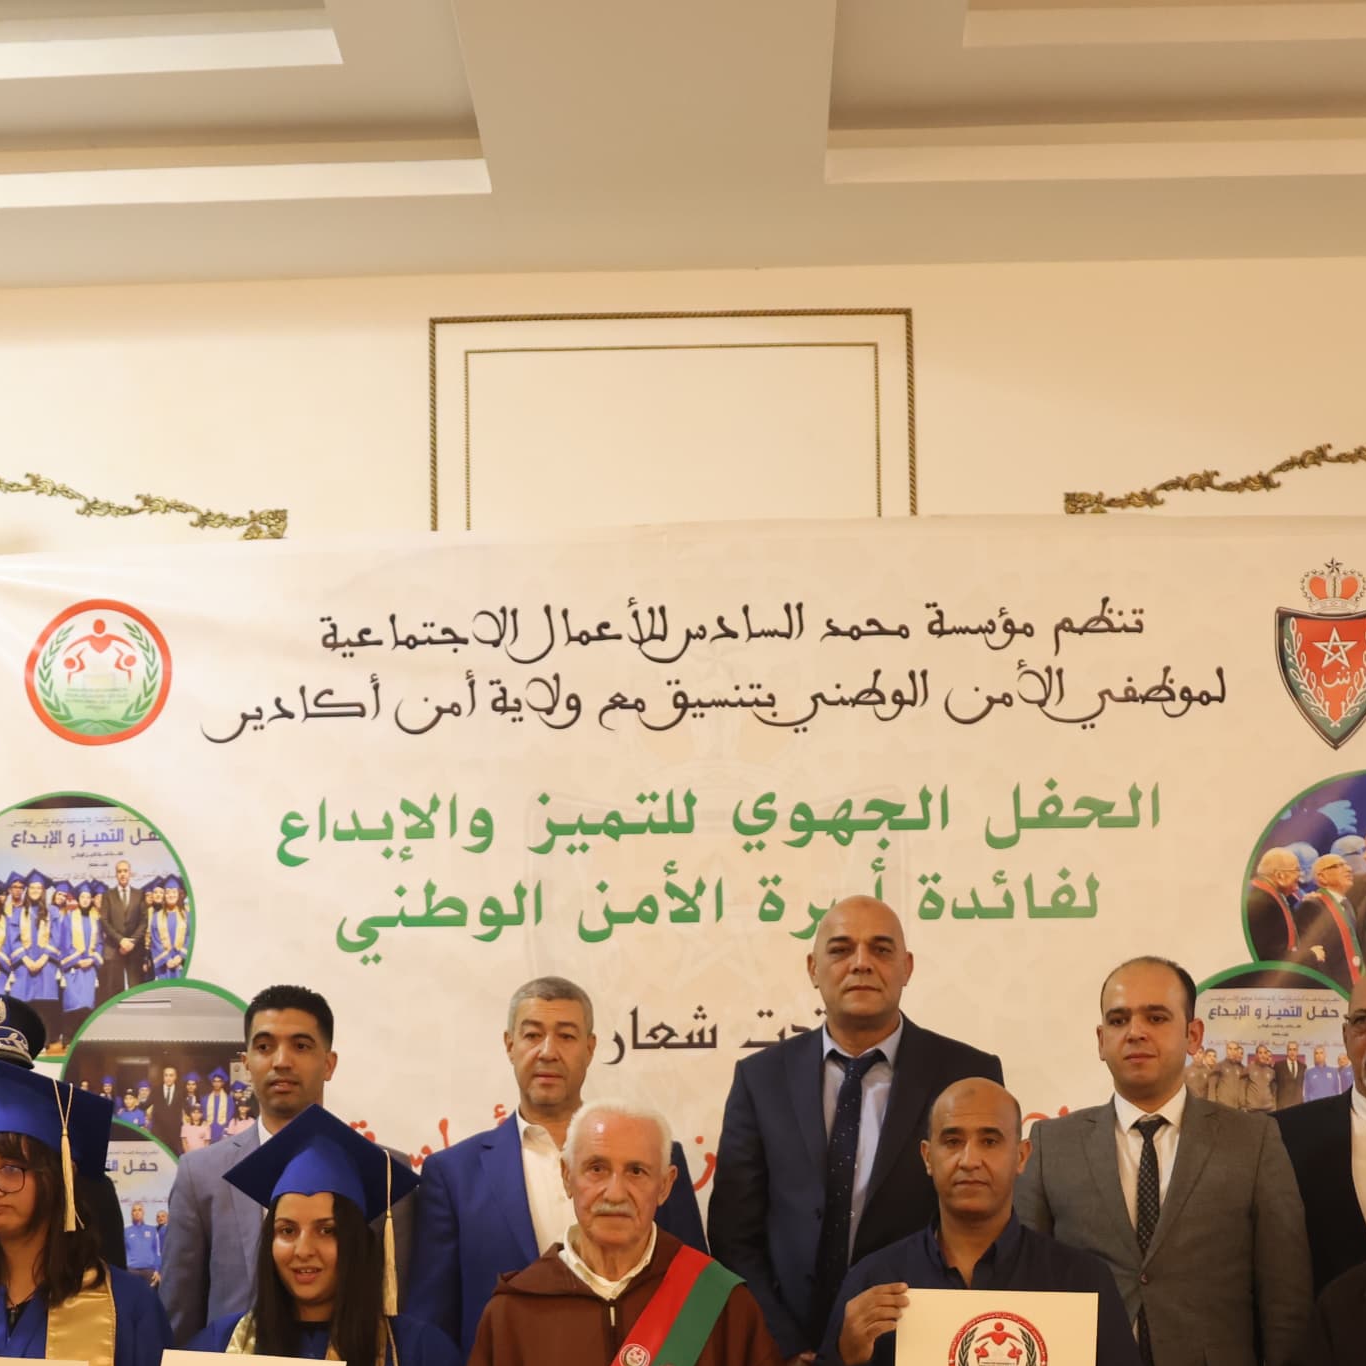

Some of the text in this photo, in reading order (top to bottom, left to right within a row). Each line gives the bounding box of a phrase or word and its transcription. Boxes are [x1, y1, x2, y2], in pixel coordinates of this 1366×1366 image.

[506, 596, 669, 665] للأعمال
[634, 602, 805, 665] السادس
[819, 617, 911, 642] محمد
[924, 601, 1036, 651] مؤسسة
[1053, 595, 1145, 658] تنظم
[201, 658, 1227, 744] لموظفي الأمن الوطني بتنسيق مع ولاية أمن أكادير
[276, 776, 1160, 868] الحفل الجهوي للتميز والإبداع
[336, 879, 545, 966] الوطني
[577, 860, 725, 945] الأمن
[918, 866, 1099, 921] لفائدة
[602, 1005, 719, 1065] شعار
[1306, 1006, 1340, 1021] حفل
